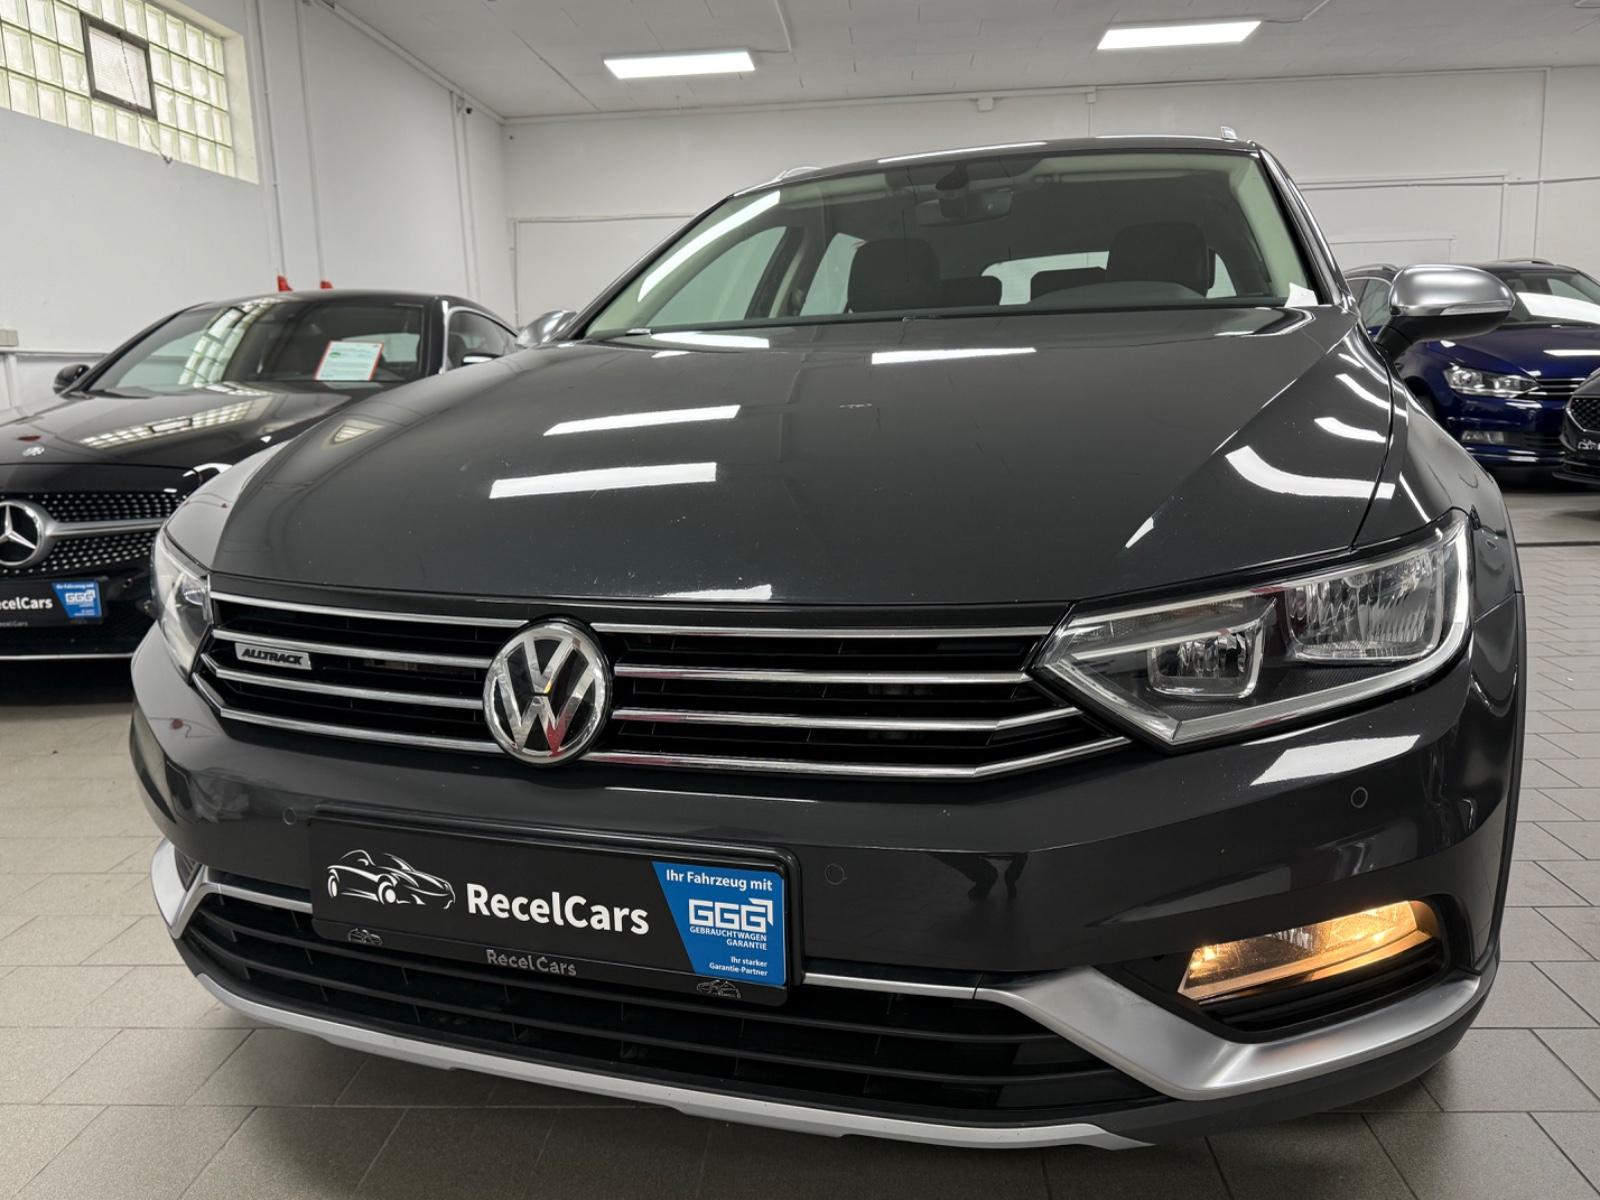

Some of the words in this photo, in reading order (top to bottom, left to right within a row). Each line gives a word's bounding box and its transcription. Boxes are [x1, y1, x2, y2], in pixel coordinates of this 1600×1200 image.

[0, 596, 53, 610] celCars
[241, 648, 303, 665] ALLTRACK
[666, 869, 684, 882] Ihr
[687, 871, 747, 891] Fahrzeug
[750, 878, 773, 891] mit
[466, 883, 650, 935] RecelCars
[688, 898, 773, 933] GGG
[689, 925, 767, 942] GEBRAUCHTWAGEN
[726, 938, 767, 951] GARANTIE
[709, 962, 768, 977] Garantie-Partner
[730, 956, 741, 964] Ihr
[742, 958, 768, 968] starker
